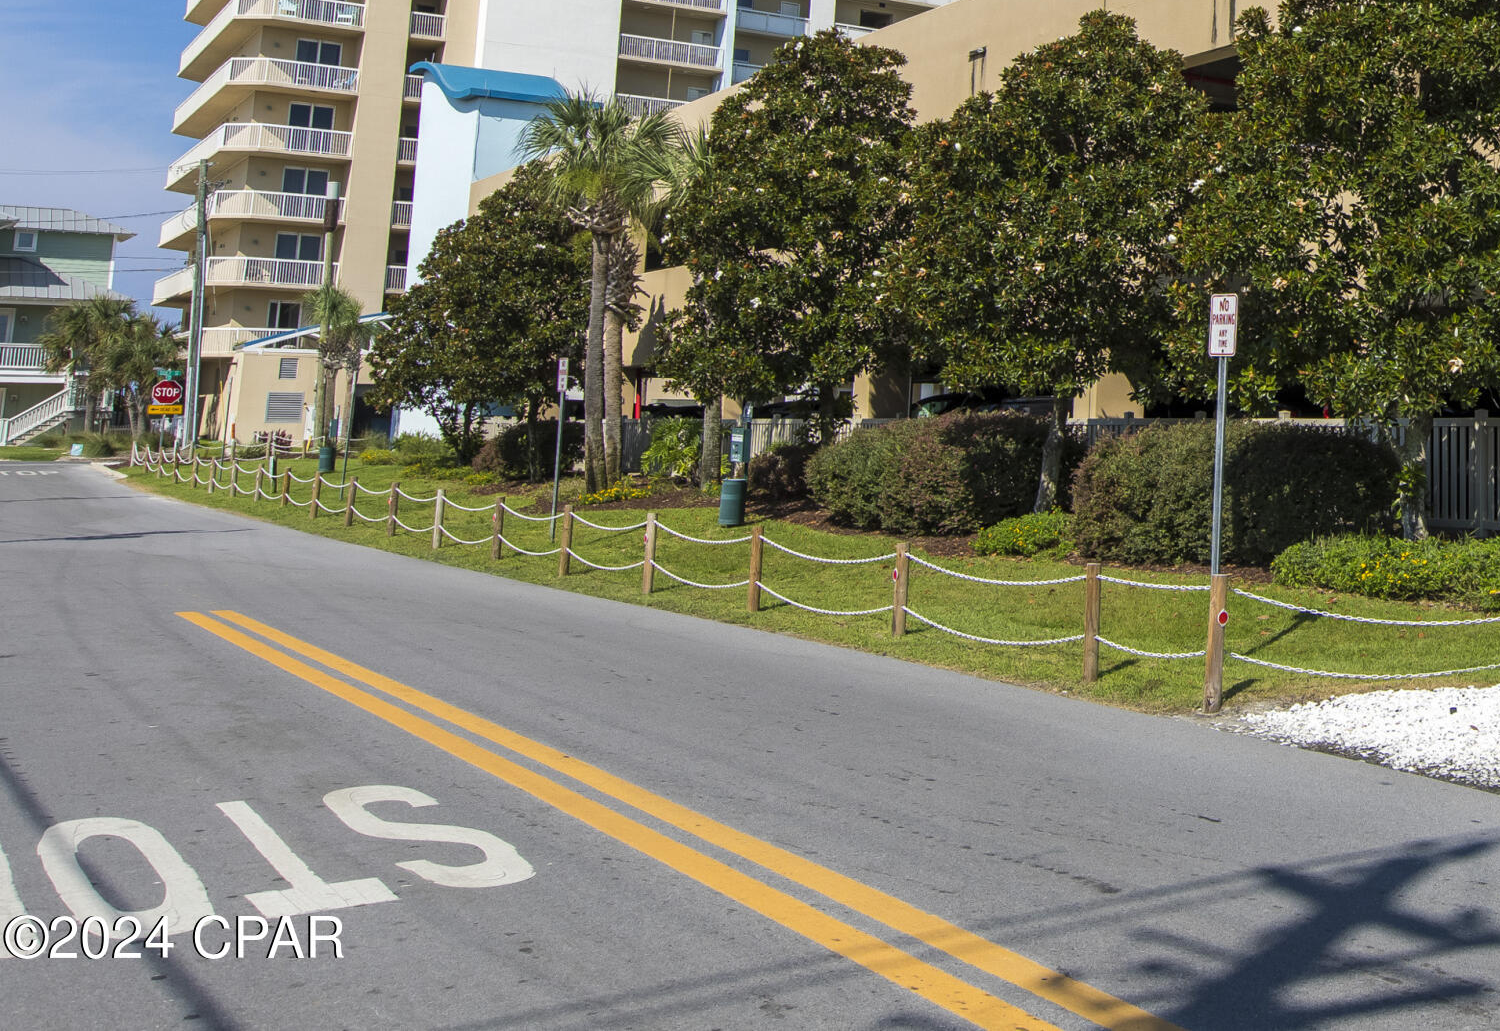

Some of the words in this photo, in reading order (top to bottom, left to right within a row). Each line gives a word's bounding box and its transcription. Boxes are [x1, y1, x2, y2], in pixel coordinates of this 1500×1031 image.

[1219, 300, 1229, 312] NO
[1212, 313, 1235, 325] PARKING
[1219, 329, 1227, 337] ANY
[154, 387, 180, 397] STOP
